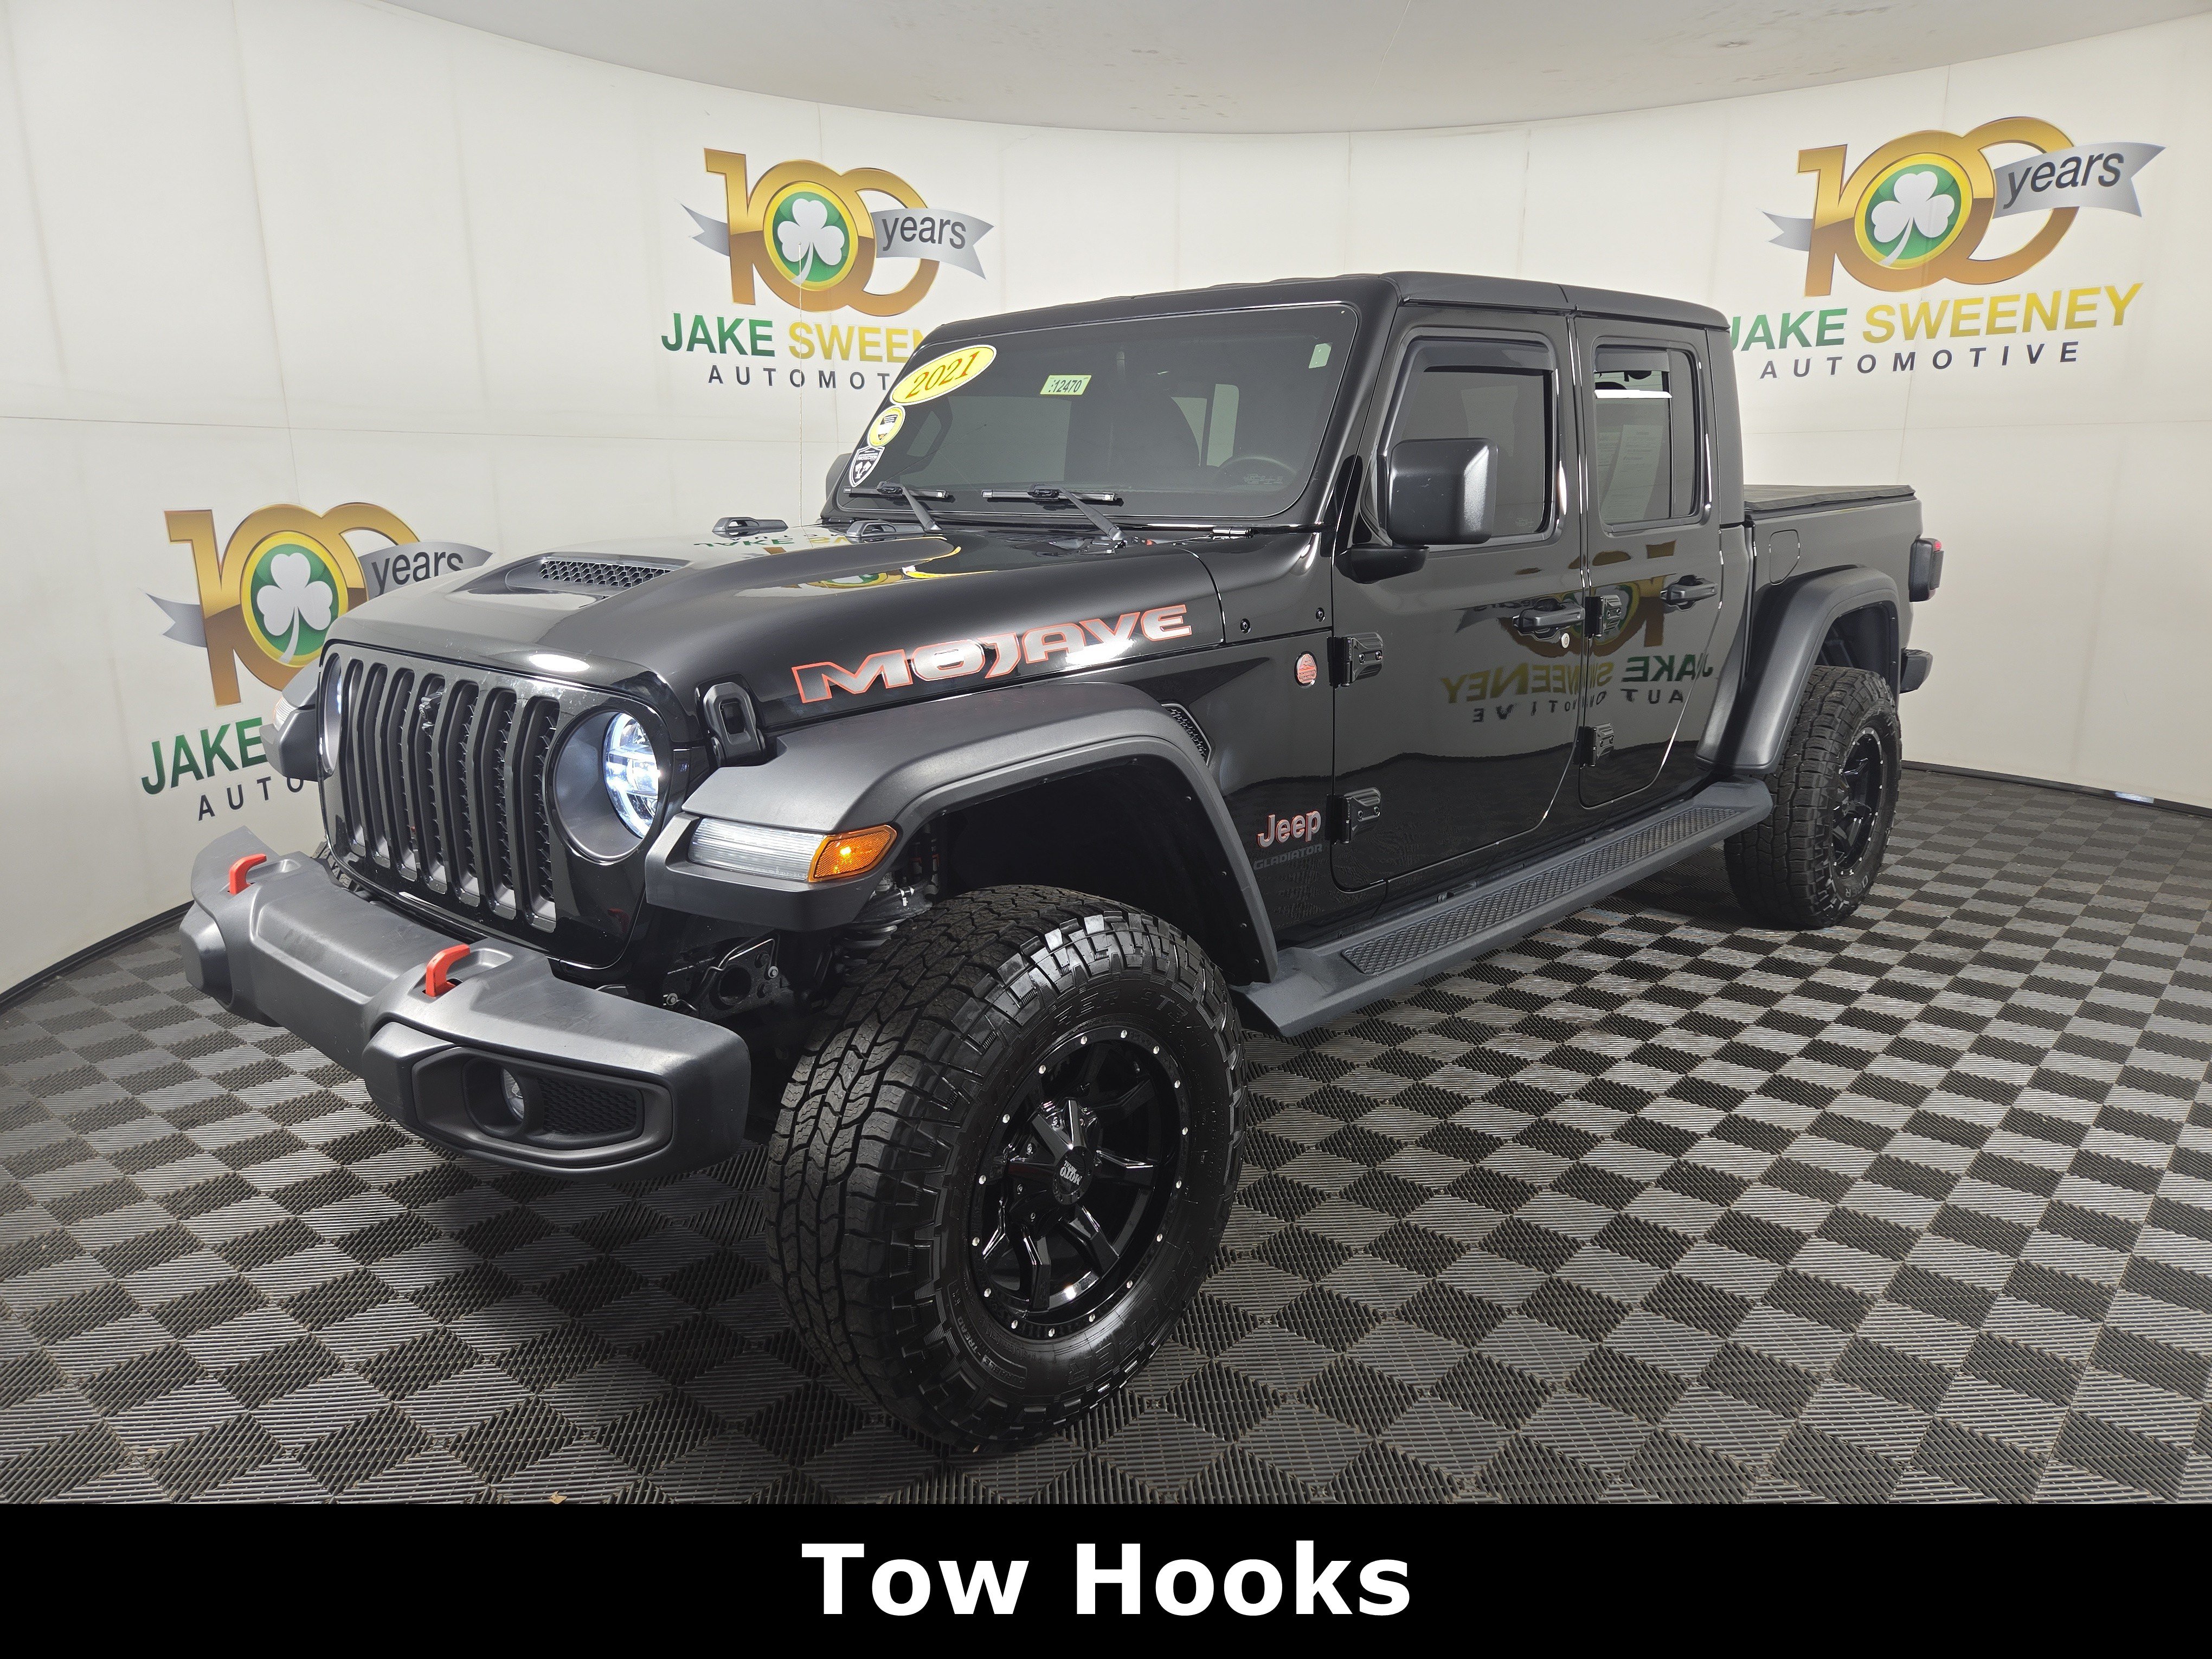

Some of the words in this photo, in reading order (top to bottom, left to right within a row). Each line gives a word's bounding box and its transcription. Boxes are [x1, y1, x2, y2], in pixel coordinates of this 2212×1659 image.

[1798, 116, 2080, 297] 100
[2003, 152, 2124, 210] years
[704, 147, 941, 317] 100
[882, 216, 967, 252] years
[661, 313, 775, 357] JAKE
[1731, 308, 1848, 351] JAKE
[1862, 283, 2144, 344] SWEENEY
[709, 365, 890, 391] AUTOMOT
[905, 351, 980, 400] 2021
[1760, 341, 2079, 380] AUTOMOTIVE
[371, 551, 464, 597] years
[792, 604, 1192, 704] MOJAVE
[140, 716, 269, 794] JAKE
[1257, 811, 1322, 848] Jeep
[1252, 843, 1323, 871] GLADIATOR
[1060, 1166, 1083, 1186] MOTO
